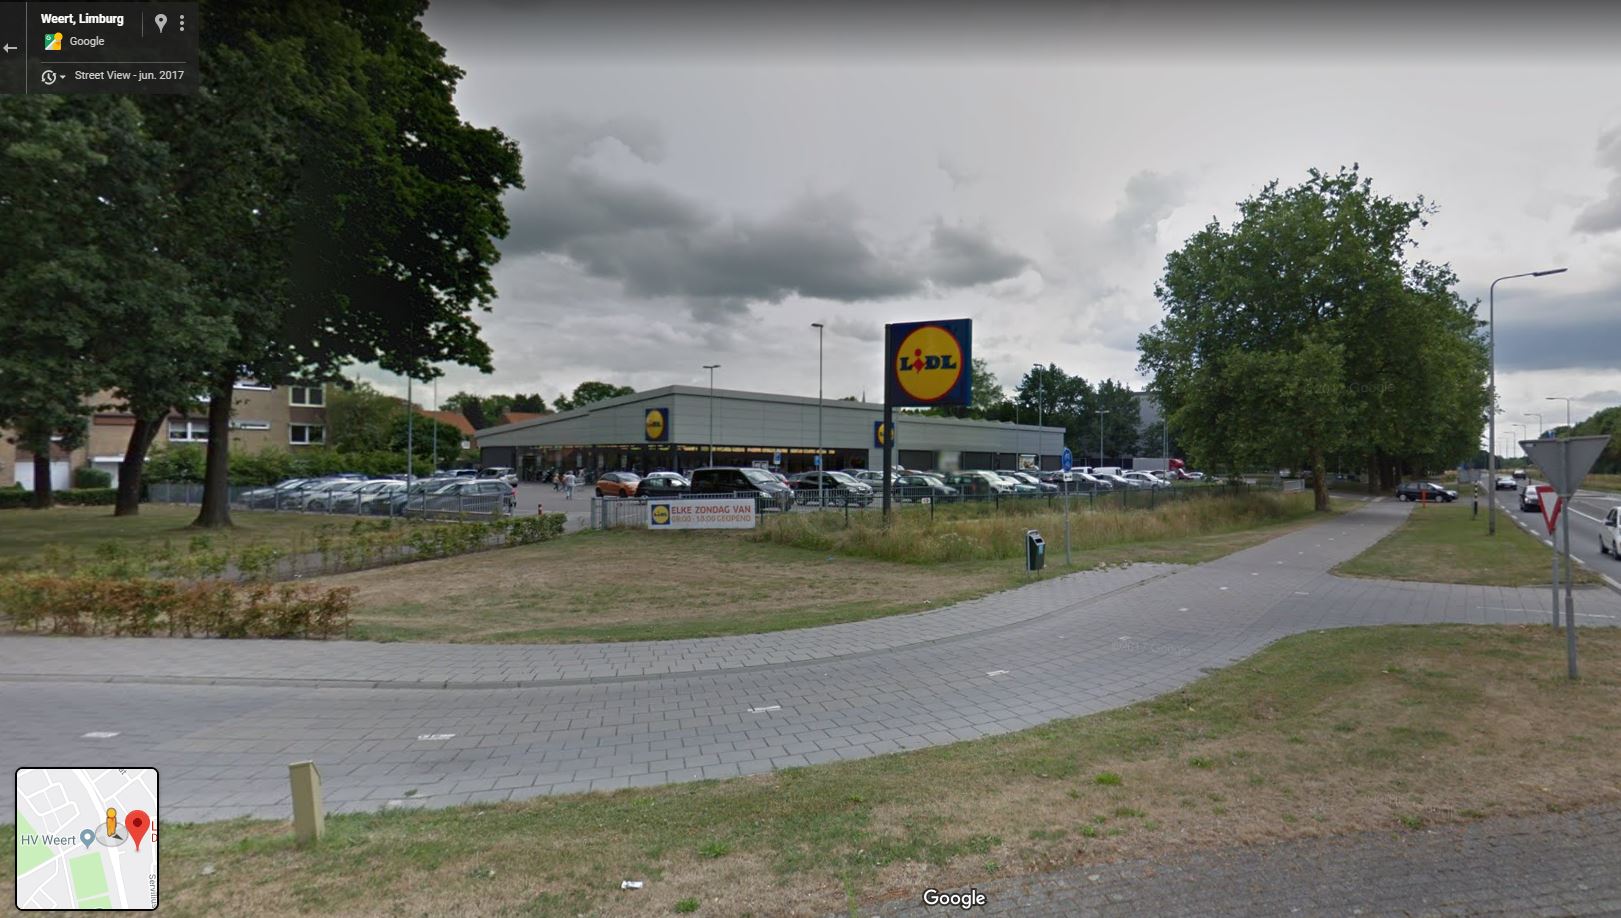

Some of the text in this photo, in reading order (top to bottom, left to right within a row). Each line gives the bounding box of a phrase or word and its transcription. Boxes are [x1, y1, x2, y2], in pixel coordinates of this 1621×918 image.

[671, 505, 751, 515] ELKE ZONDAG VAN
